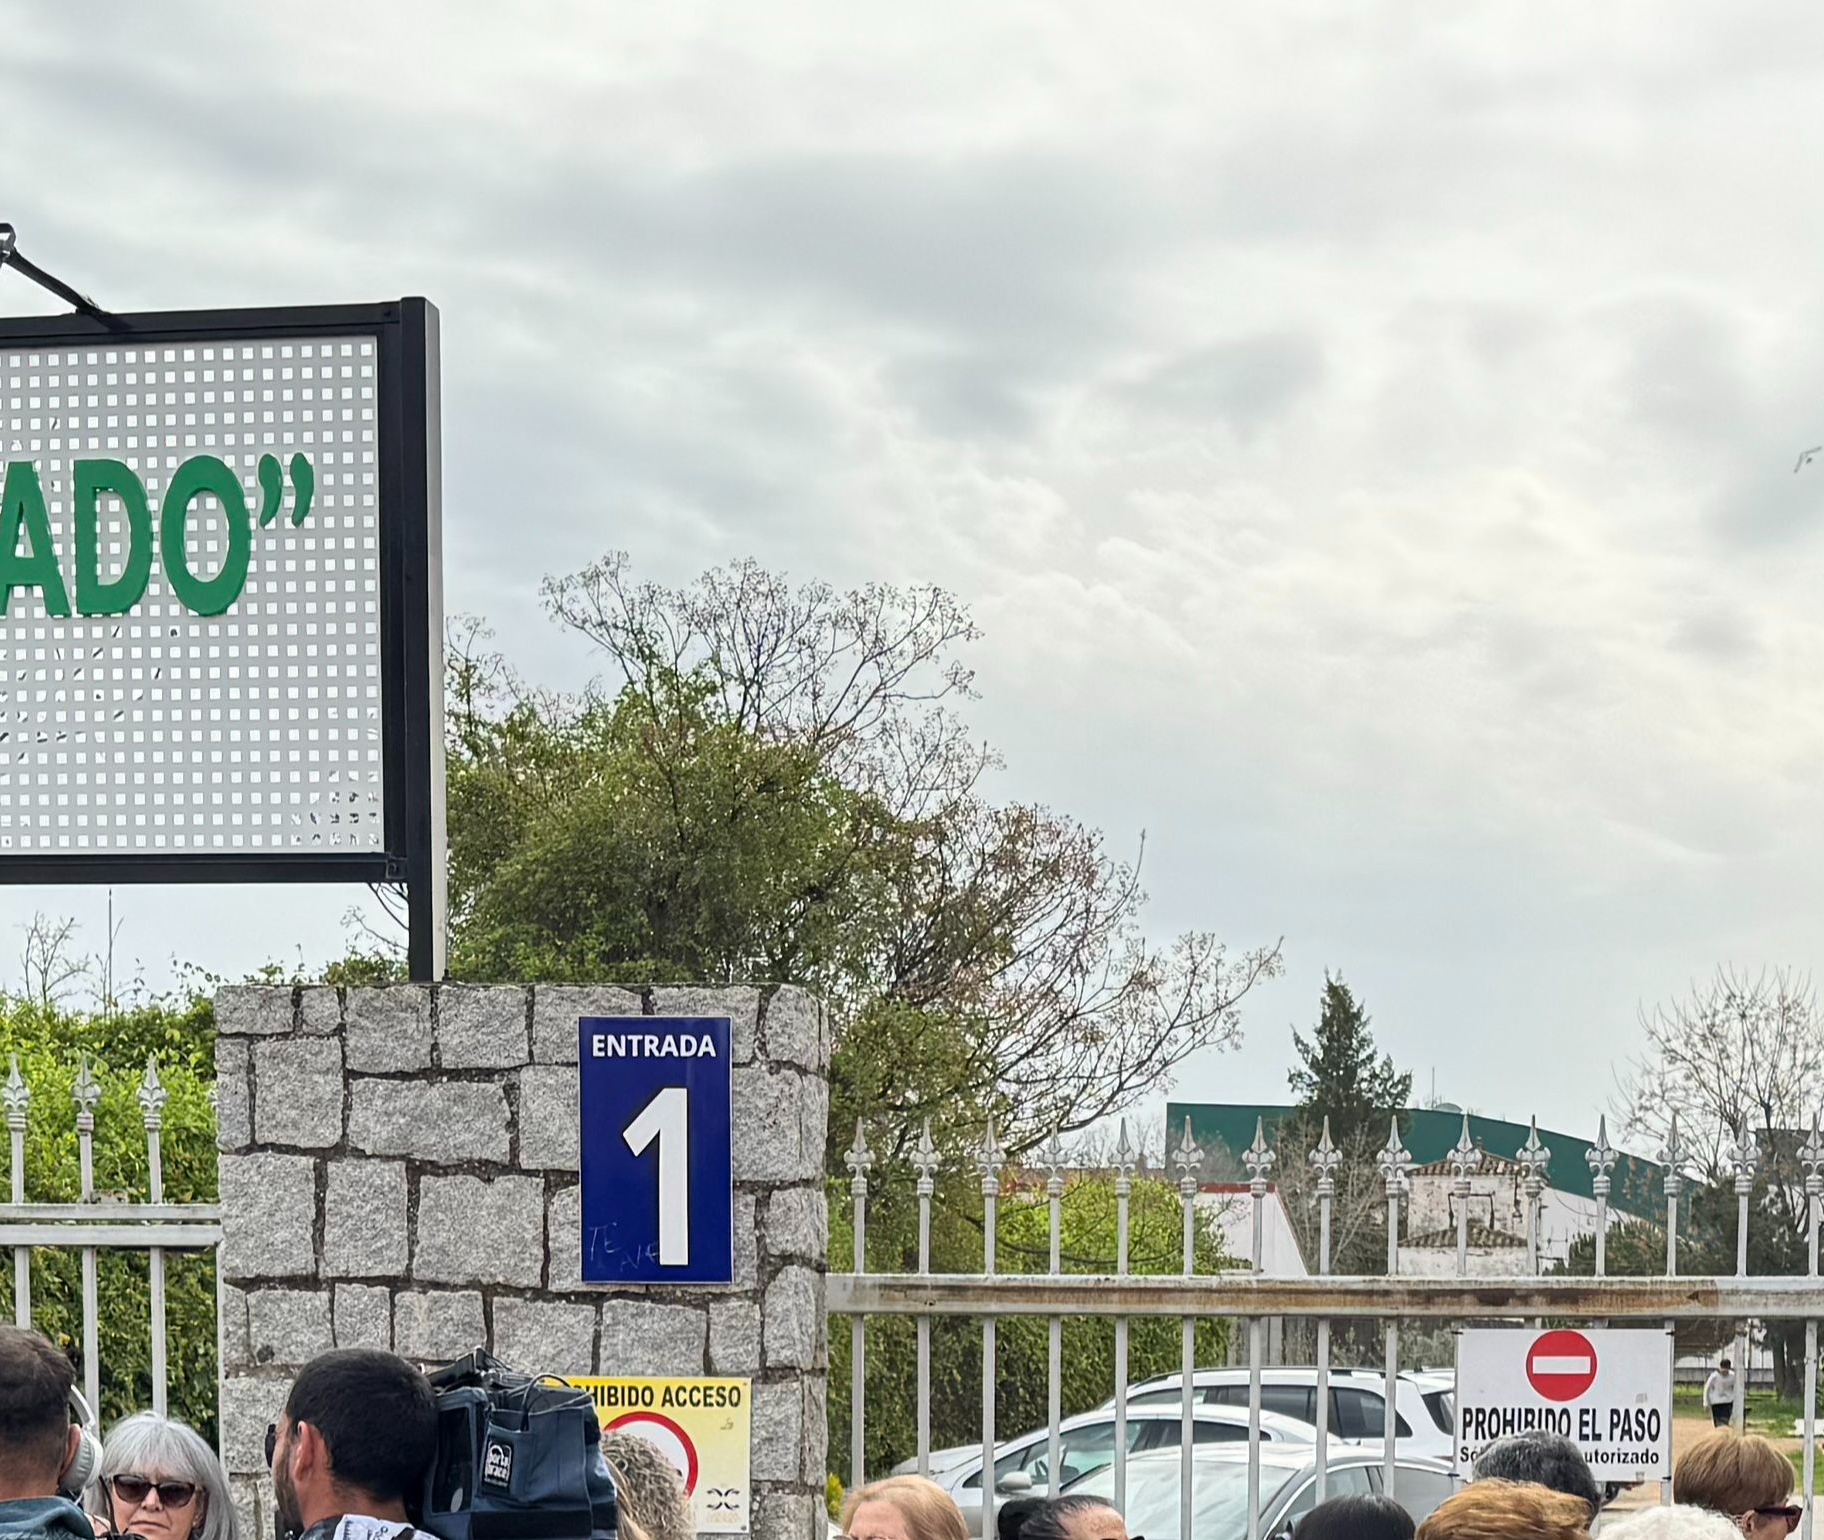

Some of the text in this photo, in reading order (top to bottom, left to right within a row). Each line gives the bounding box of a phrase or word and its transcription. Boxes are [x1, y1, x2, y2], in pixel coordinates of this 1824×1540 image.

[592, 1033, 717, 1058] ENTRADA
[622, 1087, 689, 1266] 1
[661, 1385, 742, 1408] ACCESO
[1578, 1408, 1602, 1442] EL
[1609, 1408, 1662, 1442] PASO
[1585, 1446, 1660, 1465] utorizado
